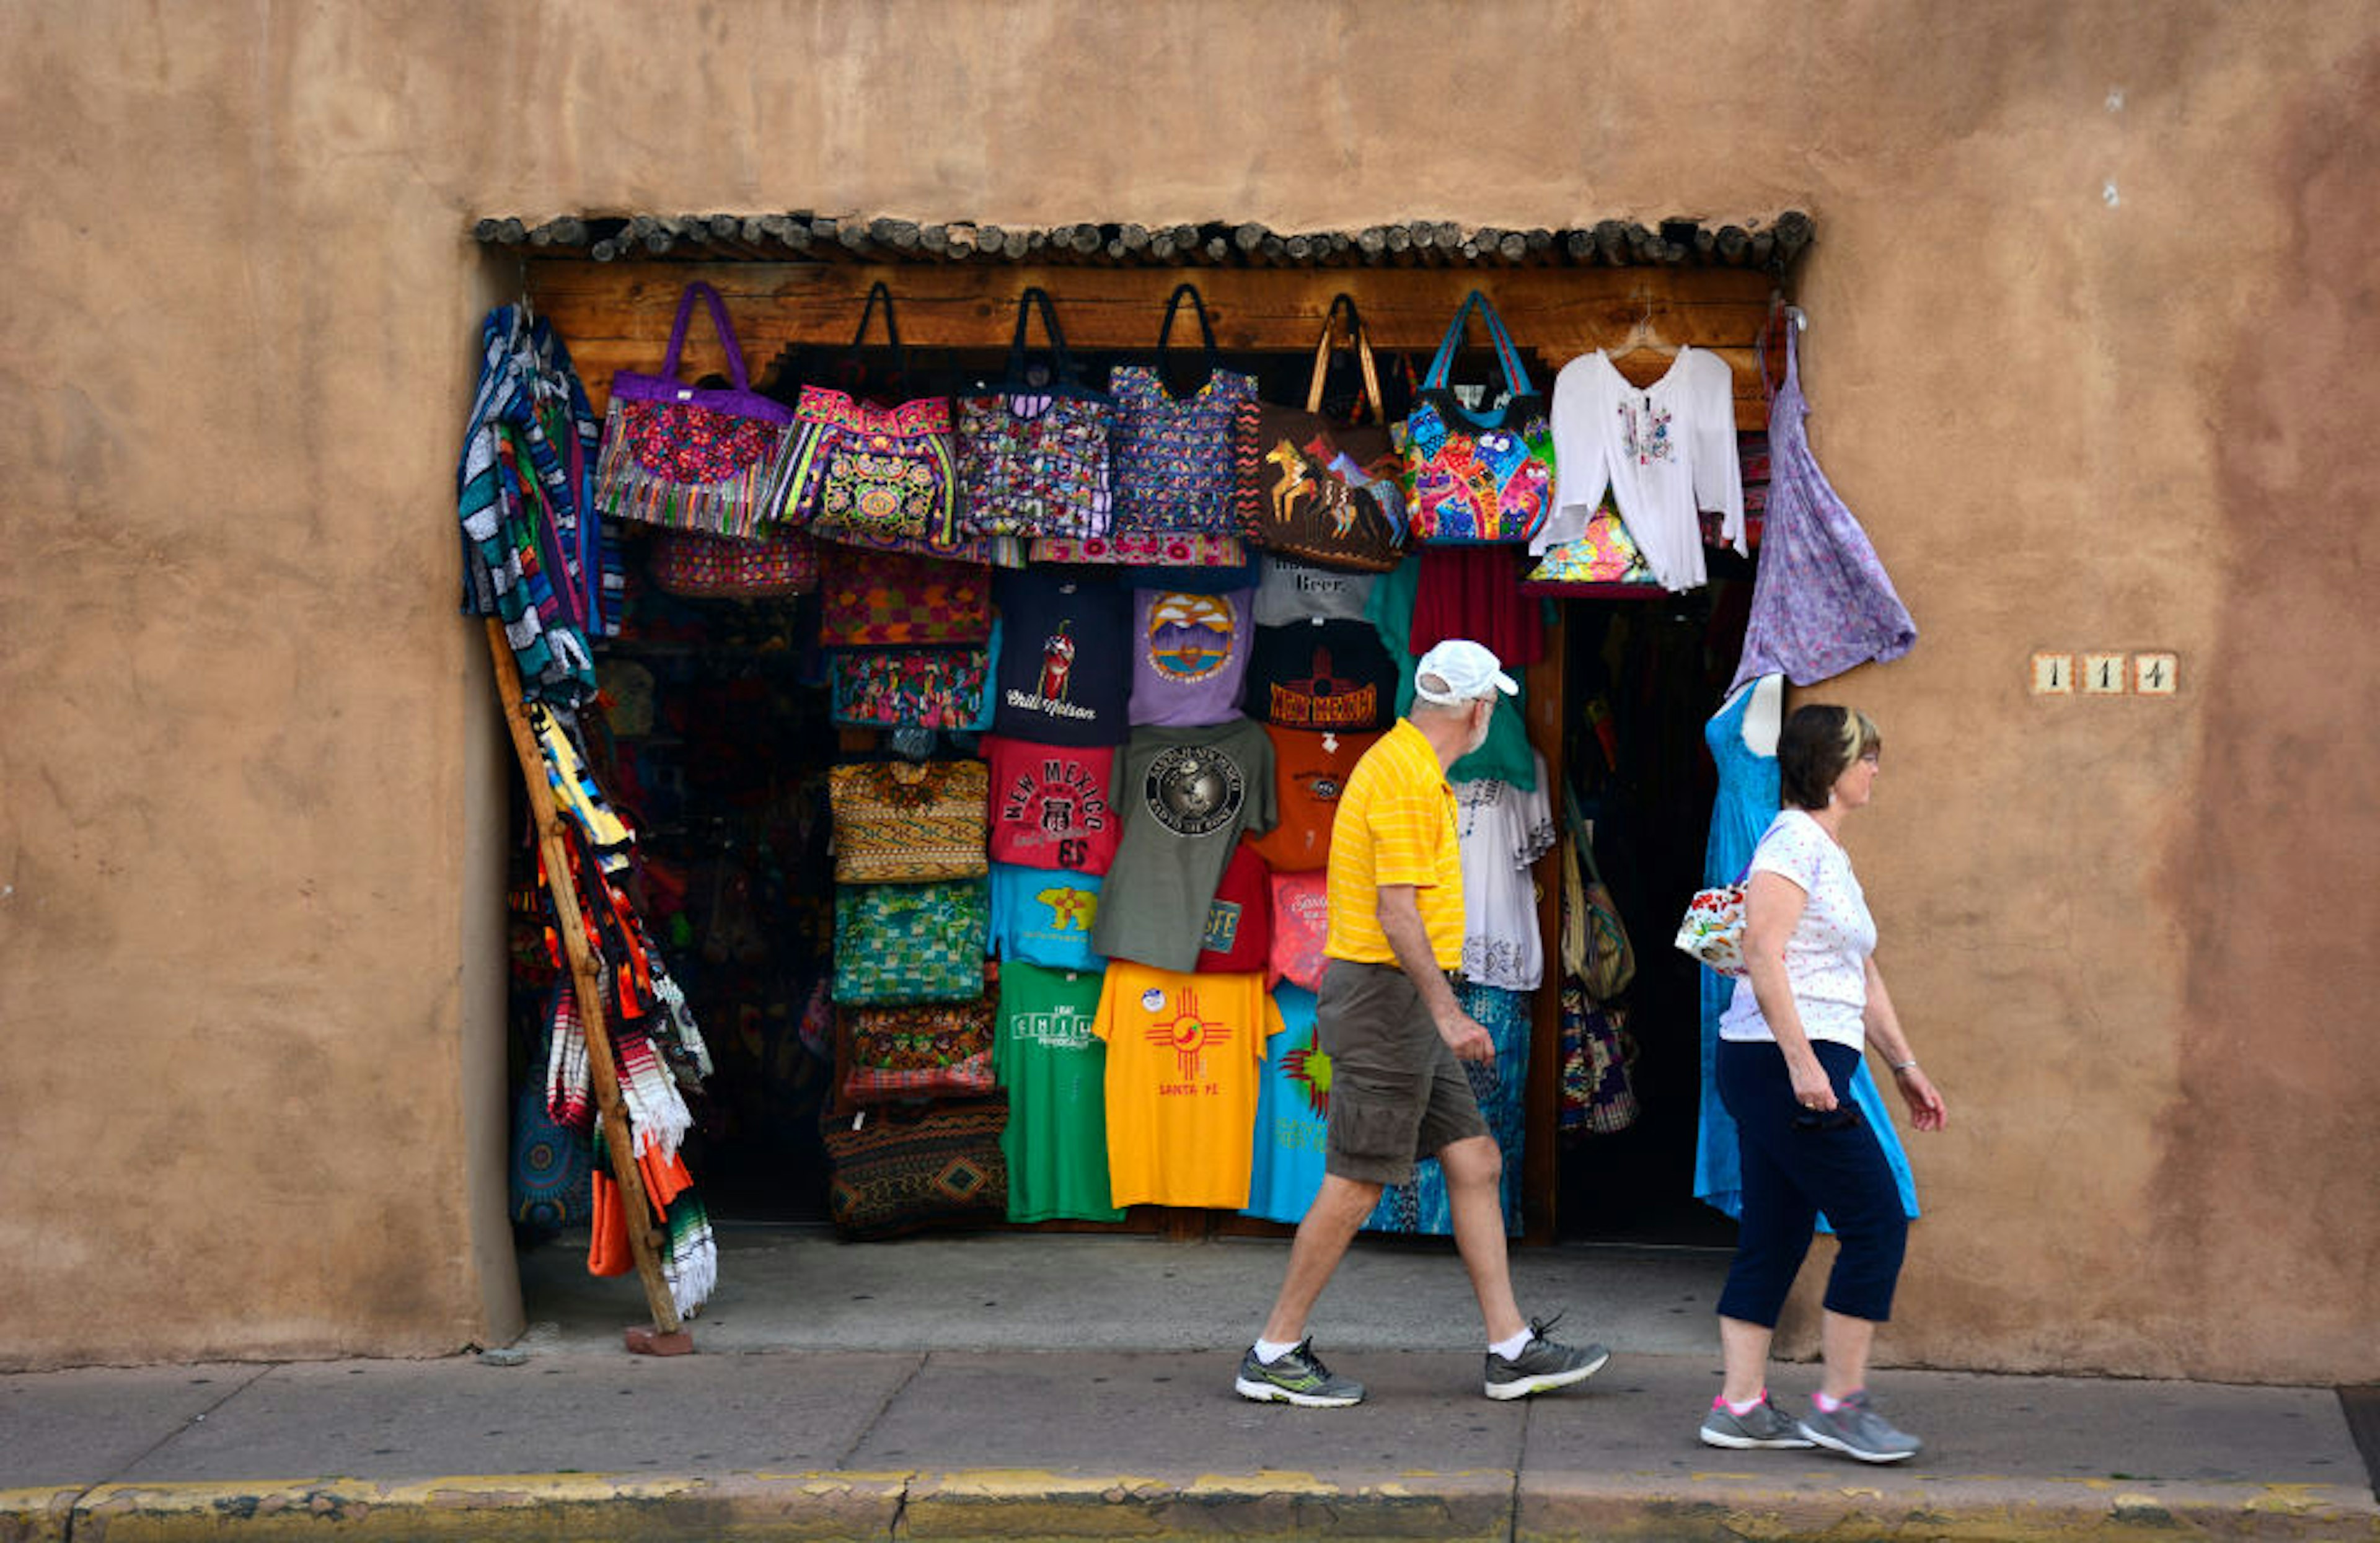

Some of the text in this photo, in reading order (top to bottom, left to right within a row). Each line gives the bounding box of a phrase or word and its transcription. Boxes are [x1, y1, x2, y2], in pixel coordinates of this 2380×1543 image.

[2047, 657, 2166, 688] 114
[1042, 698, 1096, 719] Nelson
[1271, 682, 1377, 723] NEW MEXICO
[1003, 759, 1104, 830] NEW MEXICO
[1159, 1083, 1219, 1096] SANTA FE
